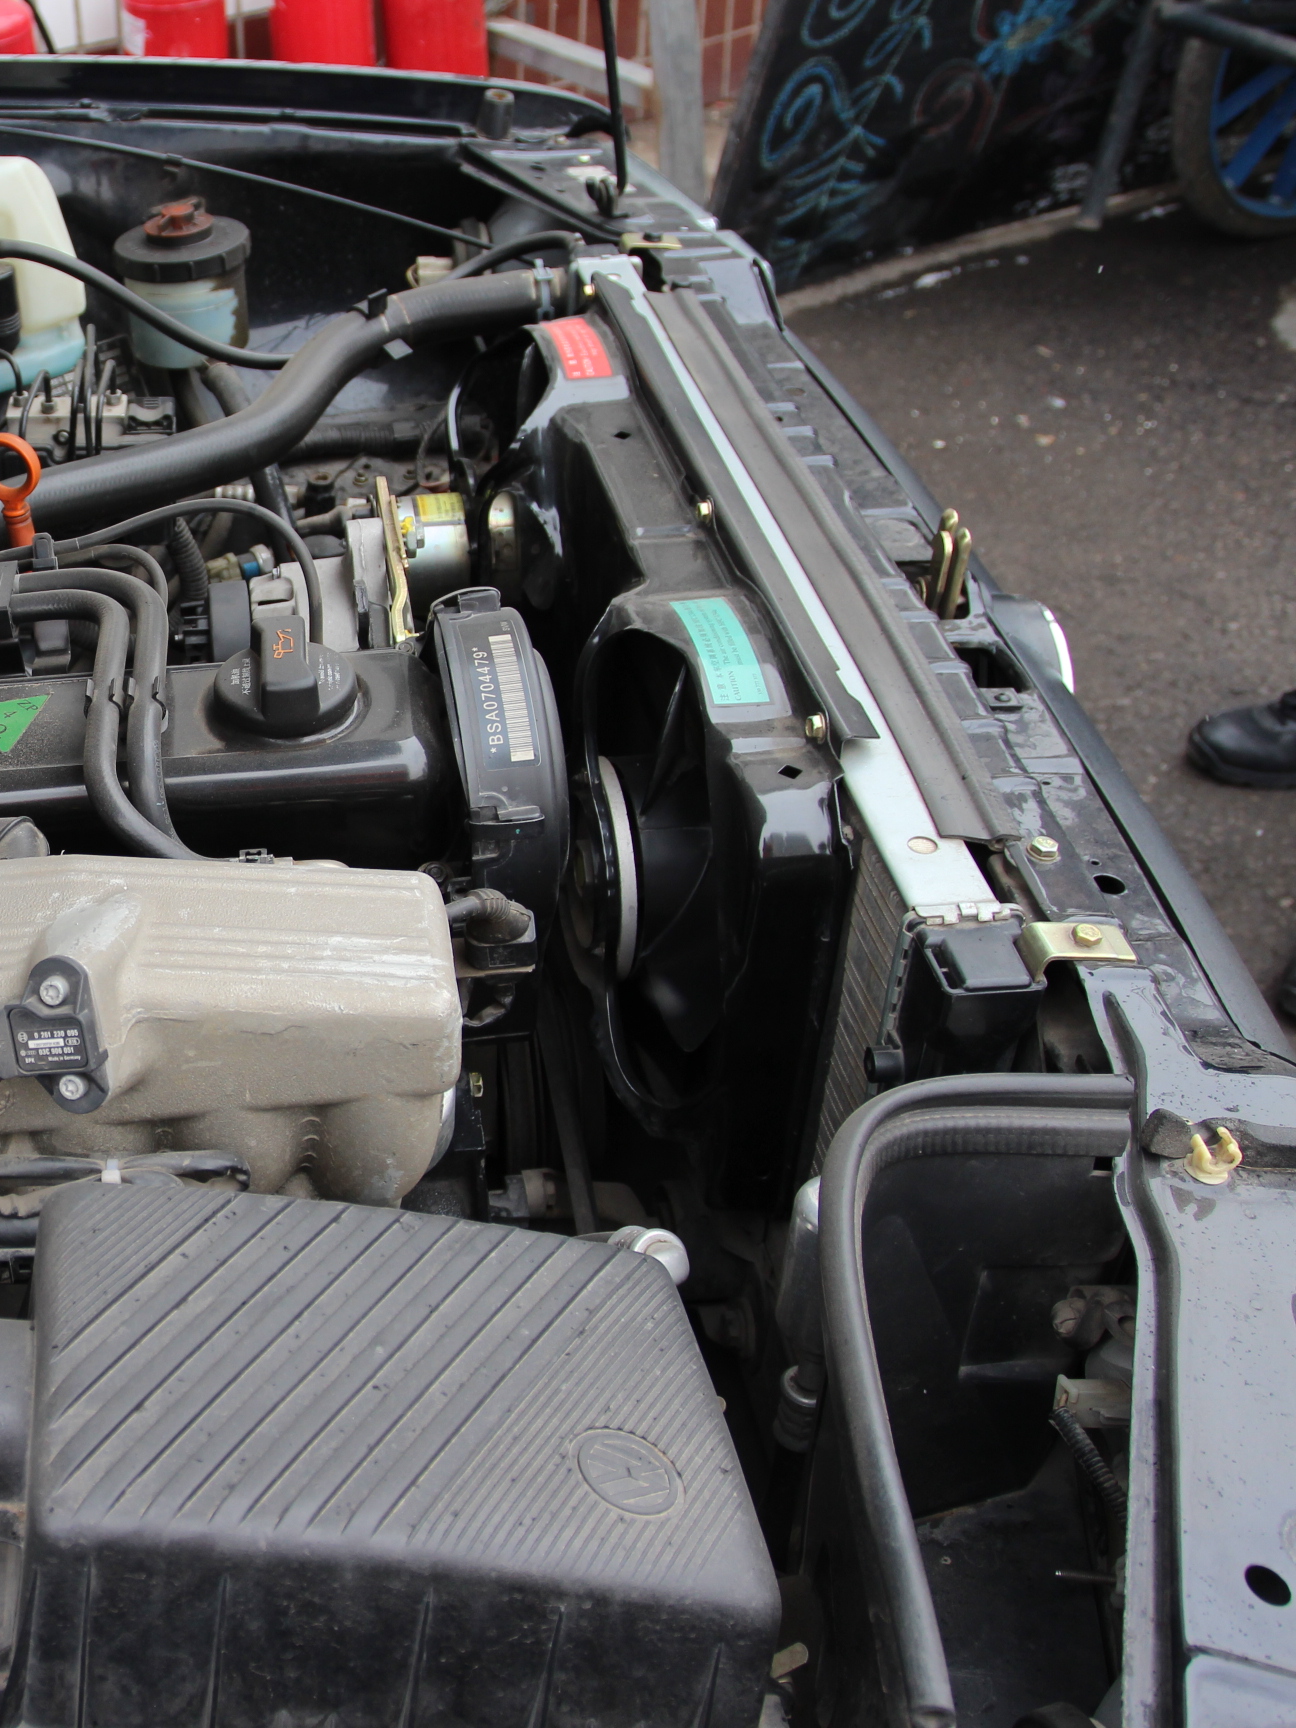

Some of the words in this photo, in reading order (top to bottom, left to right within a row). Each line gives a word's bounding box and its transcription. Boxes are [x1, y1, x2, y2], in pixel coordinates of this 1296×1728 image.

[728, 670, 742, 701] CAUTION
[17, 700, 39, 711] ZP
[4, 711, 18, 719] 4
